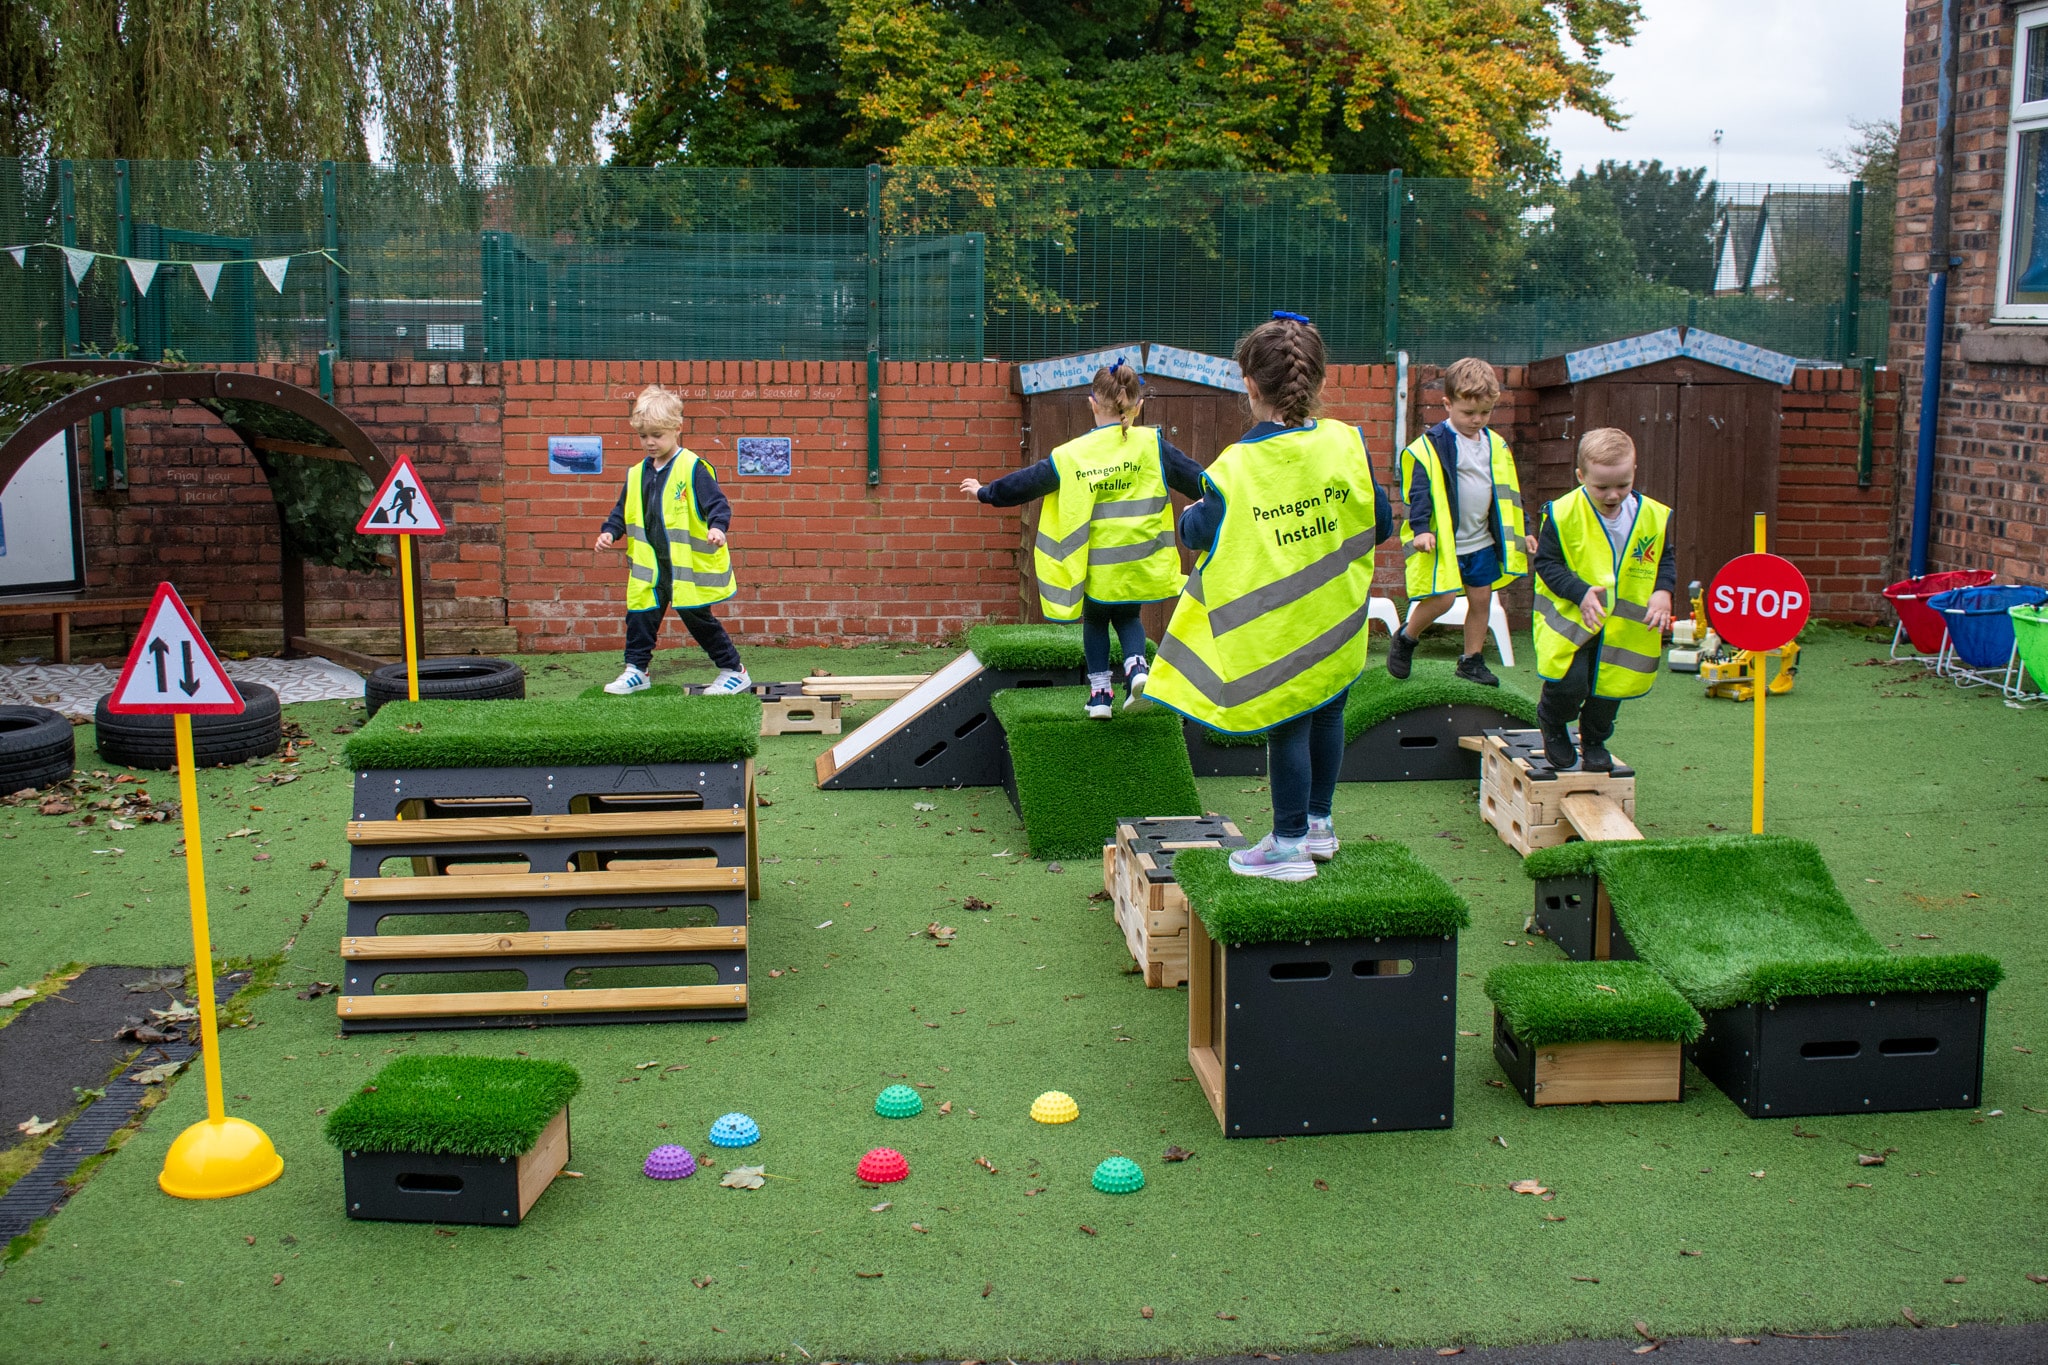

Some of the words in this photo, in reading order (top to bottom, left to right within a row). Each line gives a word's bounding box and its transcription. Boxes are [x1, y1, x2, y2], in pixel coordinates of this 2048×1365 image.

[1053, 367, 1083, 378] Music
[1173, 359, 1216, 377] Role-Play
[613, 386, 636, 399] Can
[694, 389, 707, 400] up
[714, 387, 737, 400] your
[763, 385, 801, 398] seaside
[813, 386, 842, 399] story?
[167, 469, 199, 482] Enjoy
[208, 472, 234, 484] your
[1075, 465, 1121, 480] Pentagon
[1123, 461, 1142, 474] Play
[1088, 478, 1132, 494] Installer
[1252, 496, 1321, 522] Pentagon
[1324, 486, 1351, 504] Play
[1275, 516, 1338, 547] Installer
[1713, 585, 1803, 620] STOP
